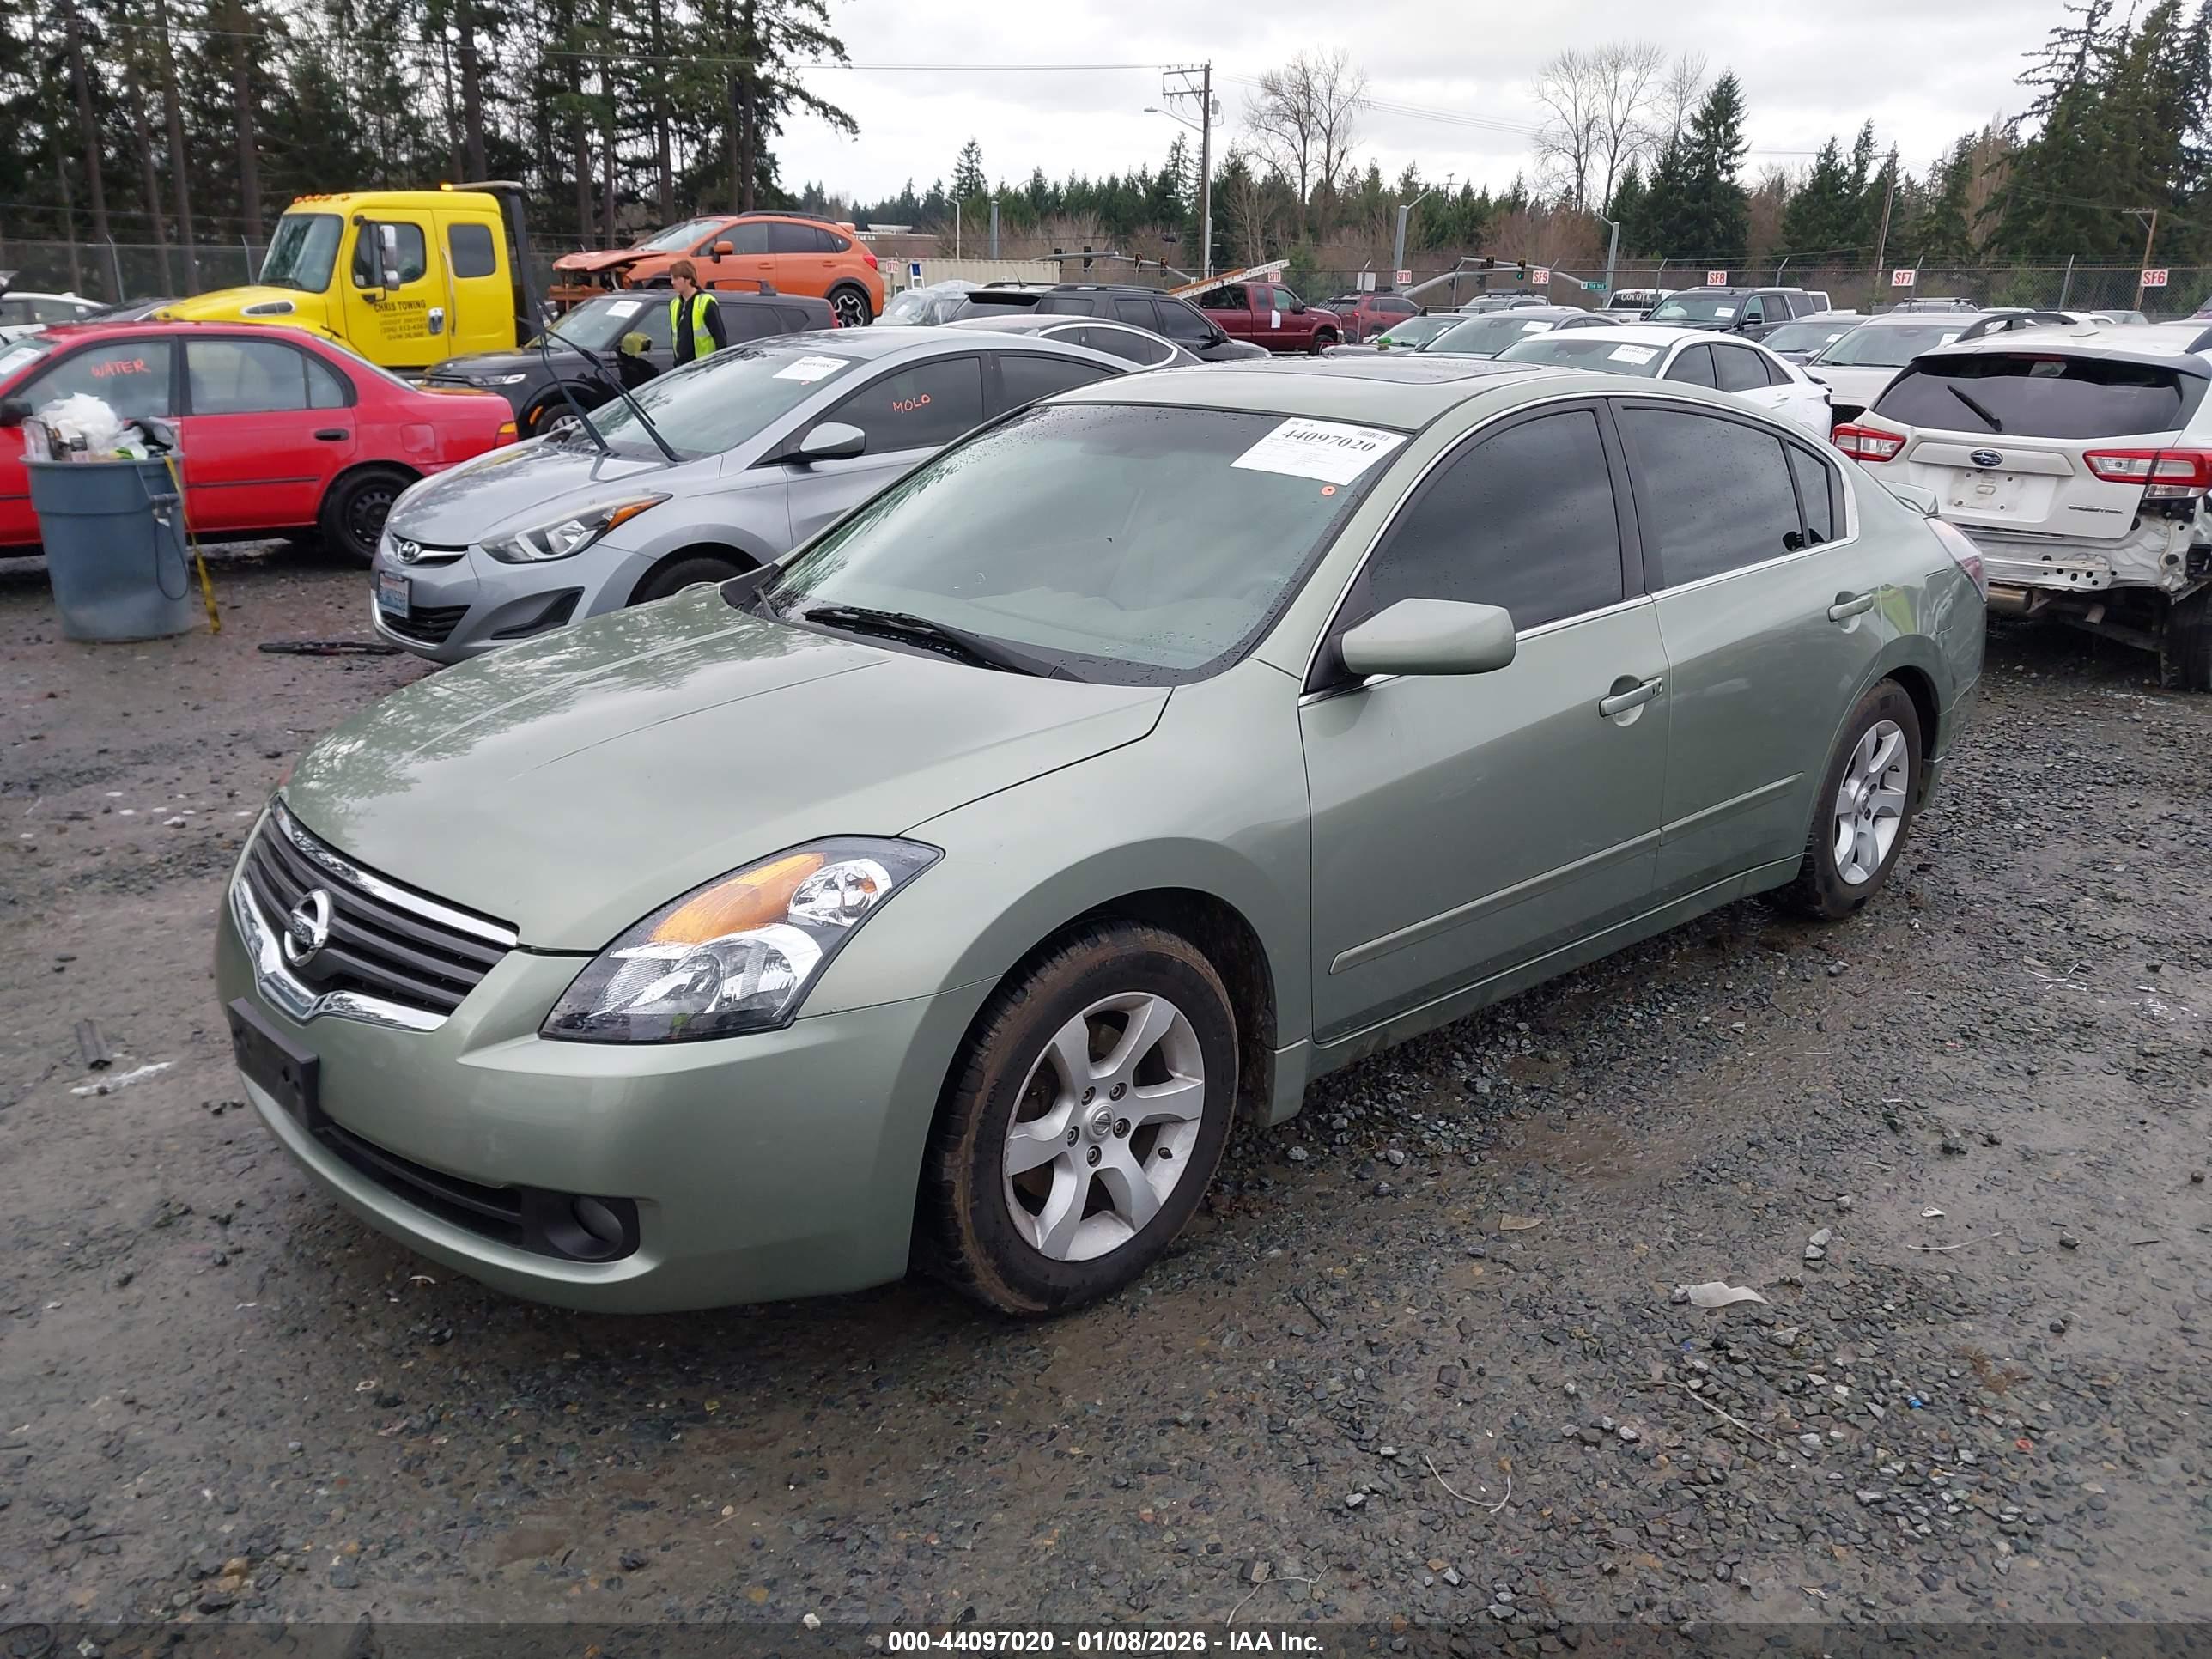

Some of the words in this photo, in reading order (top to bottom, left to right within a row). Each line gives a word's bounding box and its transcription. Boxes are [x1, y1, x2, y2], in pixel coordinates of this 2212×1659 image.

[1397, 272, 1411, 283] SF10
[1534, 271, 1548, 283] SF9
[1710, 272, 1725, 283] SF8
[1894, 272, 1912, 284] SF7
[2143, 271, 2166, 284] SF6
[1620, 293, 1651, 301] COYOTE
[374, 301, 396, 312] CHRIS
[398, 299, 426, 310] TOWING
[91, 358, 151, 378] WATER
[1282, 429, 1376, 452] 44097020
